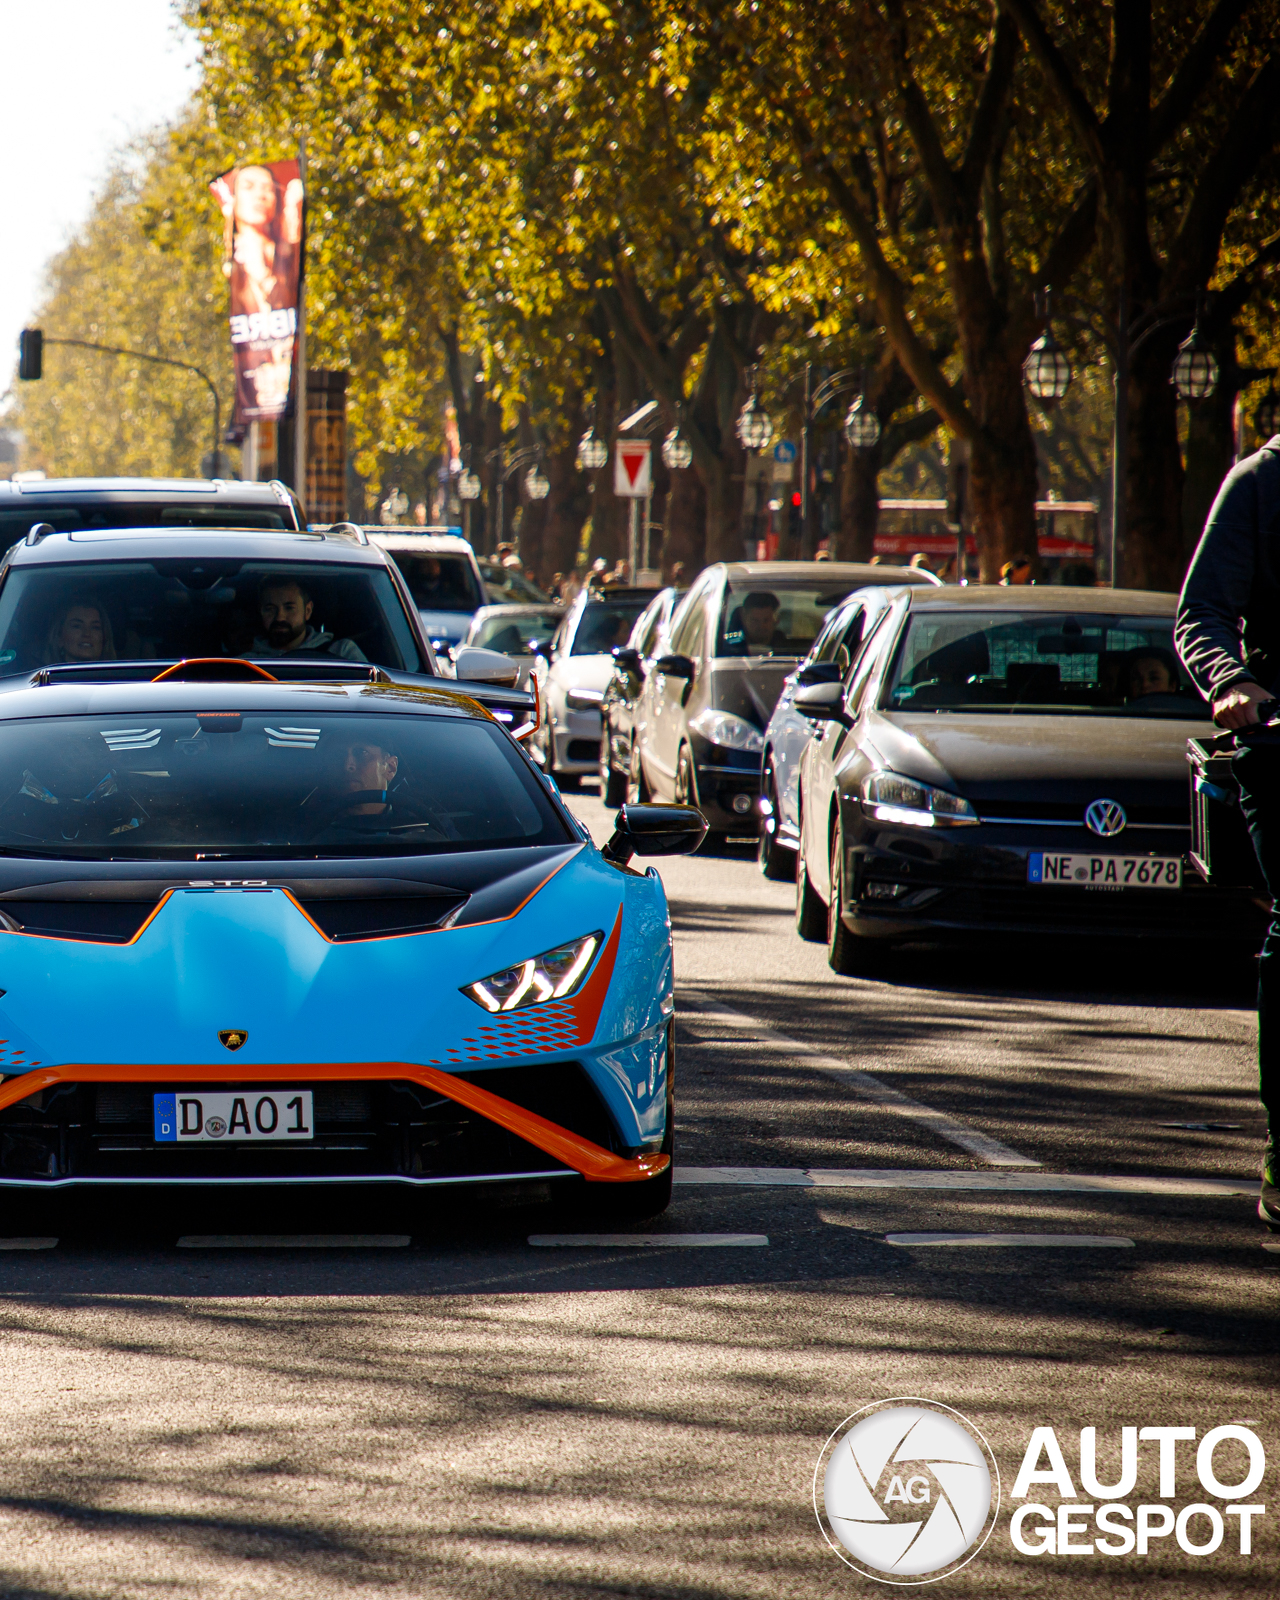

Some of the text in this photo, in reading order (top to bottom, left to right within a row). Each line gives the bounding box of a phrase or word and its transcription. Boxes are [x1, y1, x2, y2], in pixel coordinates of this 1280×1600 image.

[1045, 857, 1072, 880] NE
[1090, 859, 1117, 882] PA
[1124, 860, 1178, 884] 7678
[161, 1123, 170, 1134] D
[179, 1099, 203, 1135] D
